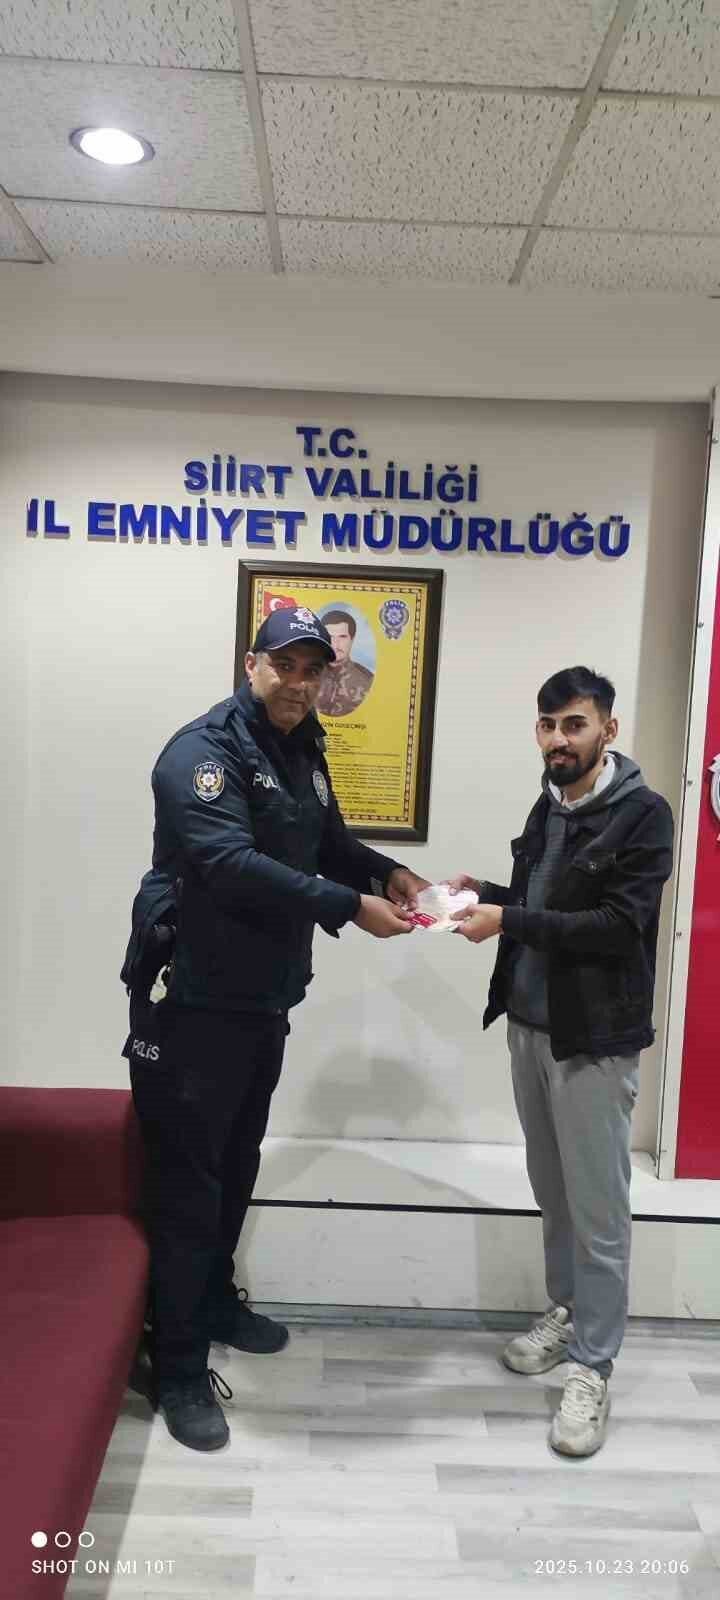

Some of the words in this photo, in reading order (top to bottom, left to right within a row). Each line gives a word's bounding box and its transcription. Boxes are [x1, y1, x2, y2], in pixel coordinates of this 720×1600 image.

[296, 426, 367, 458] T.C.
[184, 454, 292, 494] SİİRT
[305, 461, 478, 502] VALİLİĞİ
[87, 498, 305, 544] EMNİYET
[321, 509, 630, 557] MÜDÜRLÜĞÜ
